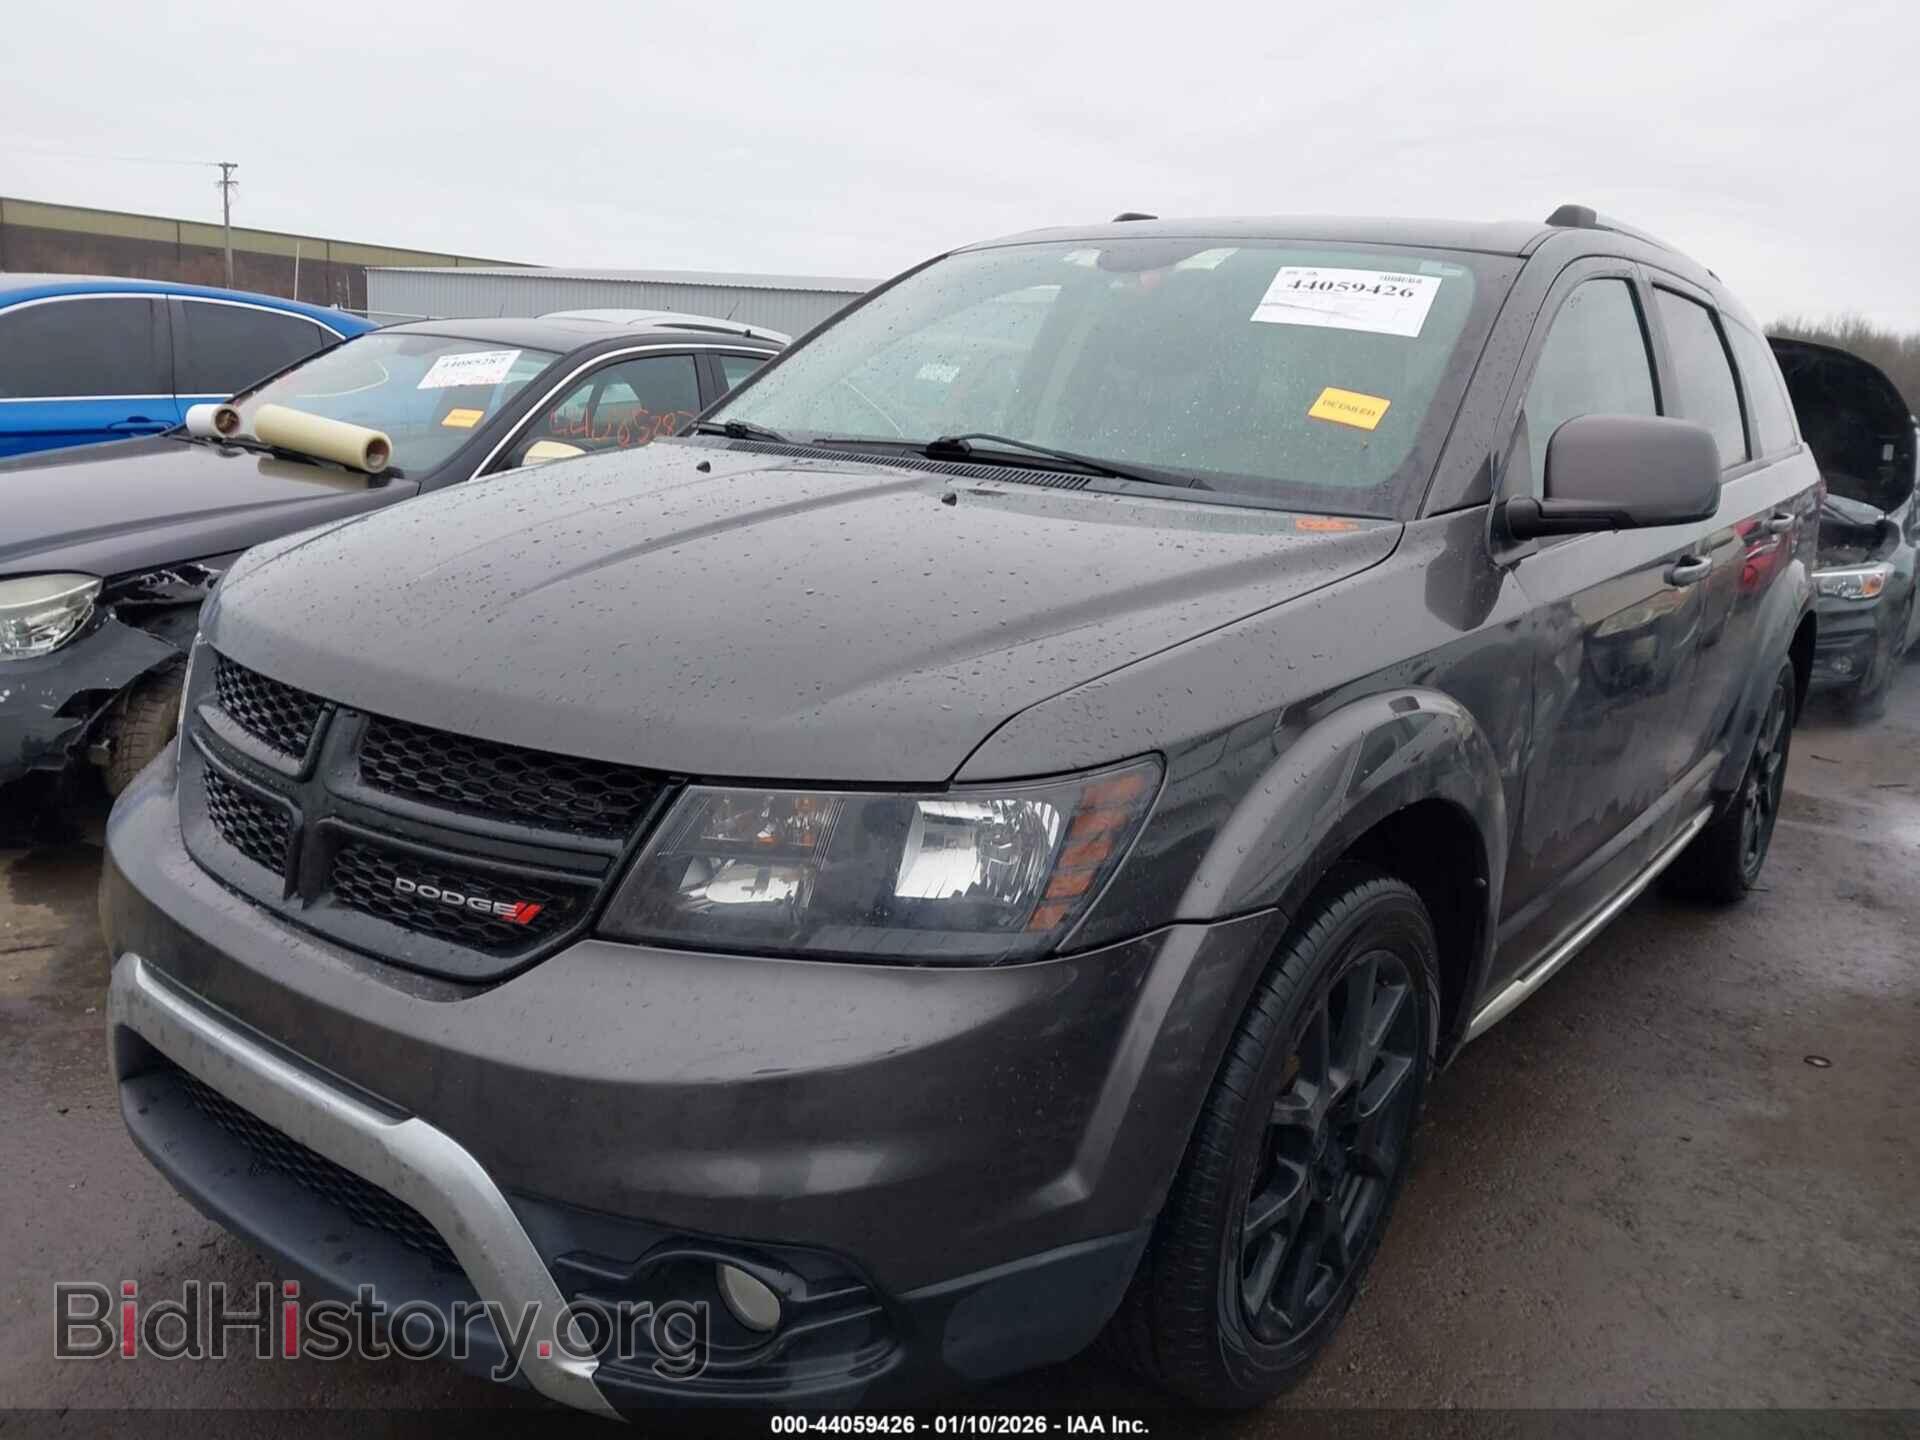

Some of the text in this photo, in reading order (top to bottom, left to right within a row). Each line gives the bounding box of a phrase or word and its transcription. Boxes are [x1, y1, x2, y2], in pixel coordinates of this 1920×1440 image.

[1287, 279, 1414, 298] 44059426
[1322, 399, 1377, 417] DETAILED
[394, 877, 517, 917] DODGE
